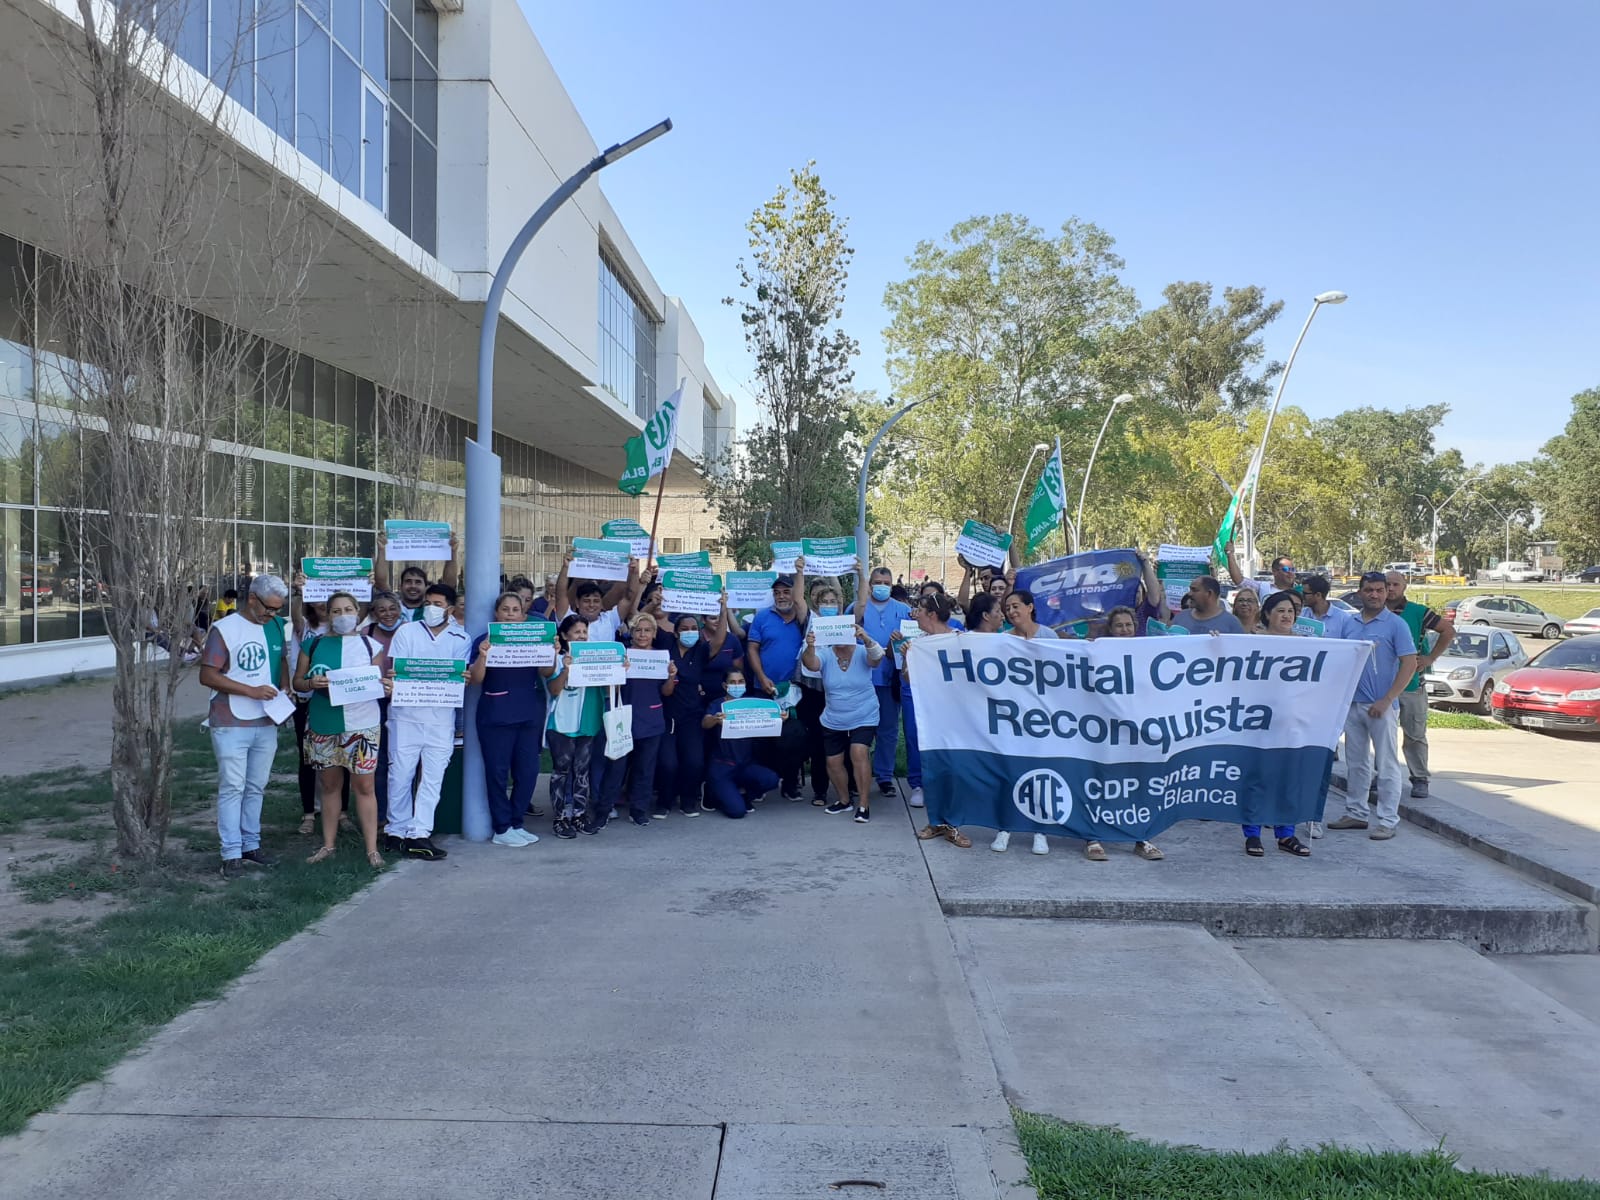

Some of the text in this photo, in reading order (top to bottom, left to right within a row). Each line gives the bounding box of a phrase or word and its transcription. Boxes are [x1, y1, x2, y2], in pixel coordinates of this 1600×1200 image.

[1030, 563, 1120, 594] CTA
[331, 674, 378, 686] TODOS SOMOS
[344, 685, 366, 693] LUCAS
[937, 649, 1328, 695] Hospital Central
[987, 697, 1274, 754] Reconquista
[1016, 771, 1068, 822] ATE
[1084, 777, 1140, 800] CDP
[1209, 760, 1242, 781] Fe
[1085, 787, 1238, 826] Verde Blanca
